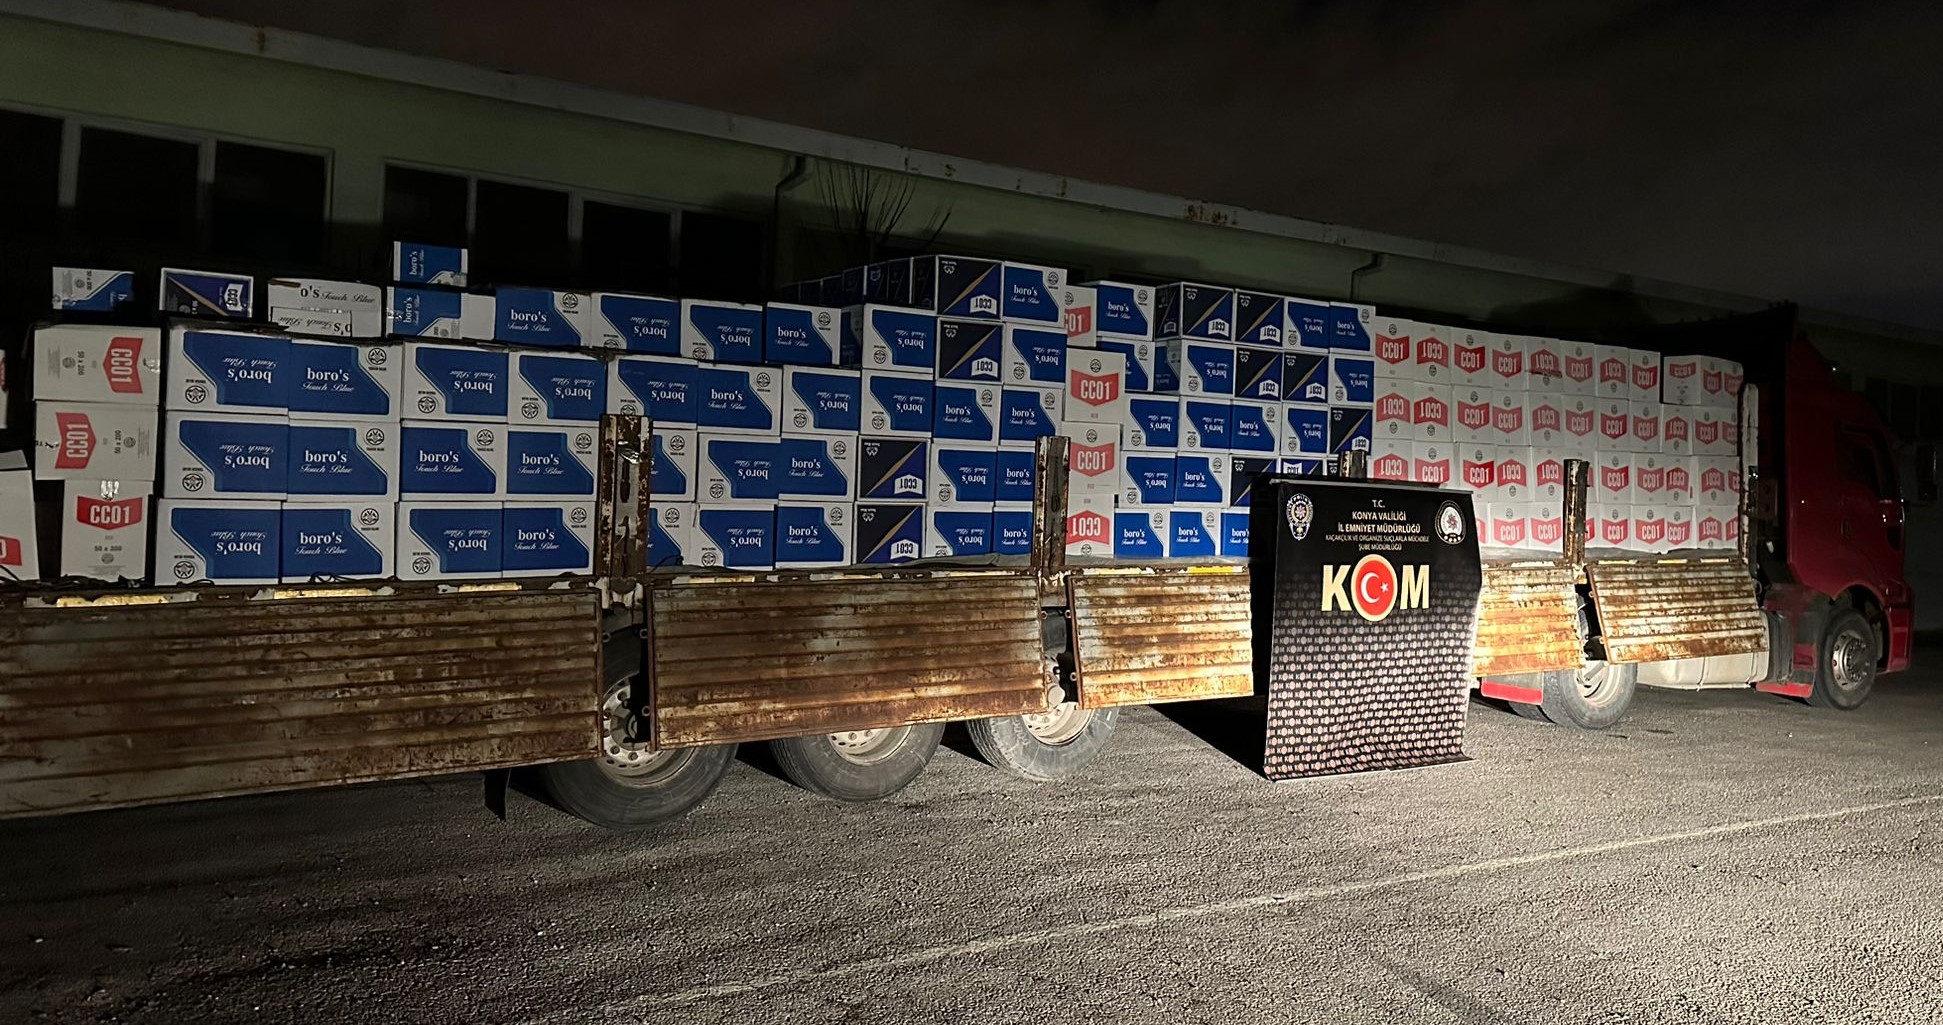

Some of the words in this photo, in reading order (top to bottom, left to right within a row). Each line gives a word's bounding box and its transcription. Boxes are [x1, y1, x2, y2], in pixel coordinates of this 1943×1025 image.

[409, 251, 417, 275] boro's
[1014, 285, 1037, 297] boro's
[402, 297, 414, 323] boro's
[1108, 302, 1129, 313] boro's
[511, 309, 546, 323] boro's
[634, 326, 666, 339] boro's
[778, 327, 806, 339] boro's
[721, 333, 750, 346] boro's
[898, 336, 923, 349] boro's
[1382, 342, 1404, 359] CC01
[1422, 342, 1442, 358] CC01
[112, 349, 132, 383] CC01
[1035, 354, 1058, 365] boro's
[1460, 351, 1480, 368] CC01
[1498, 356, 1517, 372] CC01
[1535, 354, 1554, 369] CC01
[228, 369, 271, 383] boro's
[307, 368, 349, 383] boro's
[1207, 369, 1227, 378] boro's
[454, 381, 492, 394] boro's
[556, 386, 591, 400] boro's
[1081, 380, 1110, 400] CC01
[652, 389, 684, 403] boro's
[712, 389, 743, 402] boro's
[820, 399, 848, 412] boro's
[896, 403, 922, 414] boro's
[946, 405, 970, 417] boro's
[1382, 400, 1404, 415] CC01
[1420, 402, 1441, 419] CC01
[1012, 408, 1035, 419] boro's
[1464, 409, 1484, 424] CC01
[1537, 409, 1555, 425] CC01
[1150, 422, 1170, 431] boro's
[1240, 420, 1258, 431] boro's
[1498, 413, 1517, 428] CC01
[1204, 423, 1223, 433] boro's
[67, 422, 88, 458] CC01
[225, 456, 269, 469] boro's
[305, 450, 347, 462] boro's
[420, 450, 458, 462] boro's
[523, 453, 559, 464] boro's
[1078, 451, 1106, 470] CC01
[792, 458, 821, 470] boro's
[1380, 460, 1402, 476] CC01
[738, 469, 768, 480] boro's
[1007, 468, 1029, 478] boro's
[1185, 472, 1205, 481] boro's
[1422, 466, 1444, 482] CC01
[1469, 468, 1489, 483] CC01
[1502, 465, 1521, 480] CC01
[1541, 464, 1559, 480] CC01
[962, 473, 986, 485] boro's
[1146, 479, 1166, 488] boro's
[1372, 500, 1385, 508] T.C.
[90, 505, 129, 524] CC01
[1351, 511, 1377, 520] KONYA
[1378, 511, 1406, 521] VALİLİĞİ
[789, 526, 818, 536] boro's
[1071, 516, 1101, 535] CC01
[1179, 527, 1198, 536] boro's
[1338, 522, 1344, 532] İL
[1345, 523, 1375, 533] EMNİYET
[1376, 523, 1421, 533] MÜDÜRLÜĞÜ
[1537, 524, 1556, 540] CC01
[300, 532, 342, 544] boro's
[518, 529, 554, 540] boro's
[1004, 528, 1027, 537] boro's
[1124, 529, 1145, 537] boro's
[1500, 524, 1520, 541] CC01
[449, 539, 487, 551] boro's
[731, 537, 761, 547] boro's
[959, 534, 982, 545] boro's
[217, 542, 261, 555] boro's
